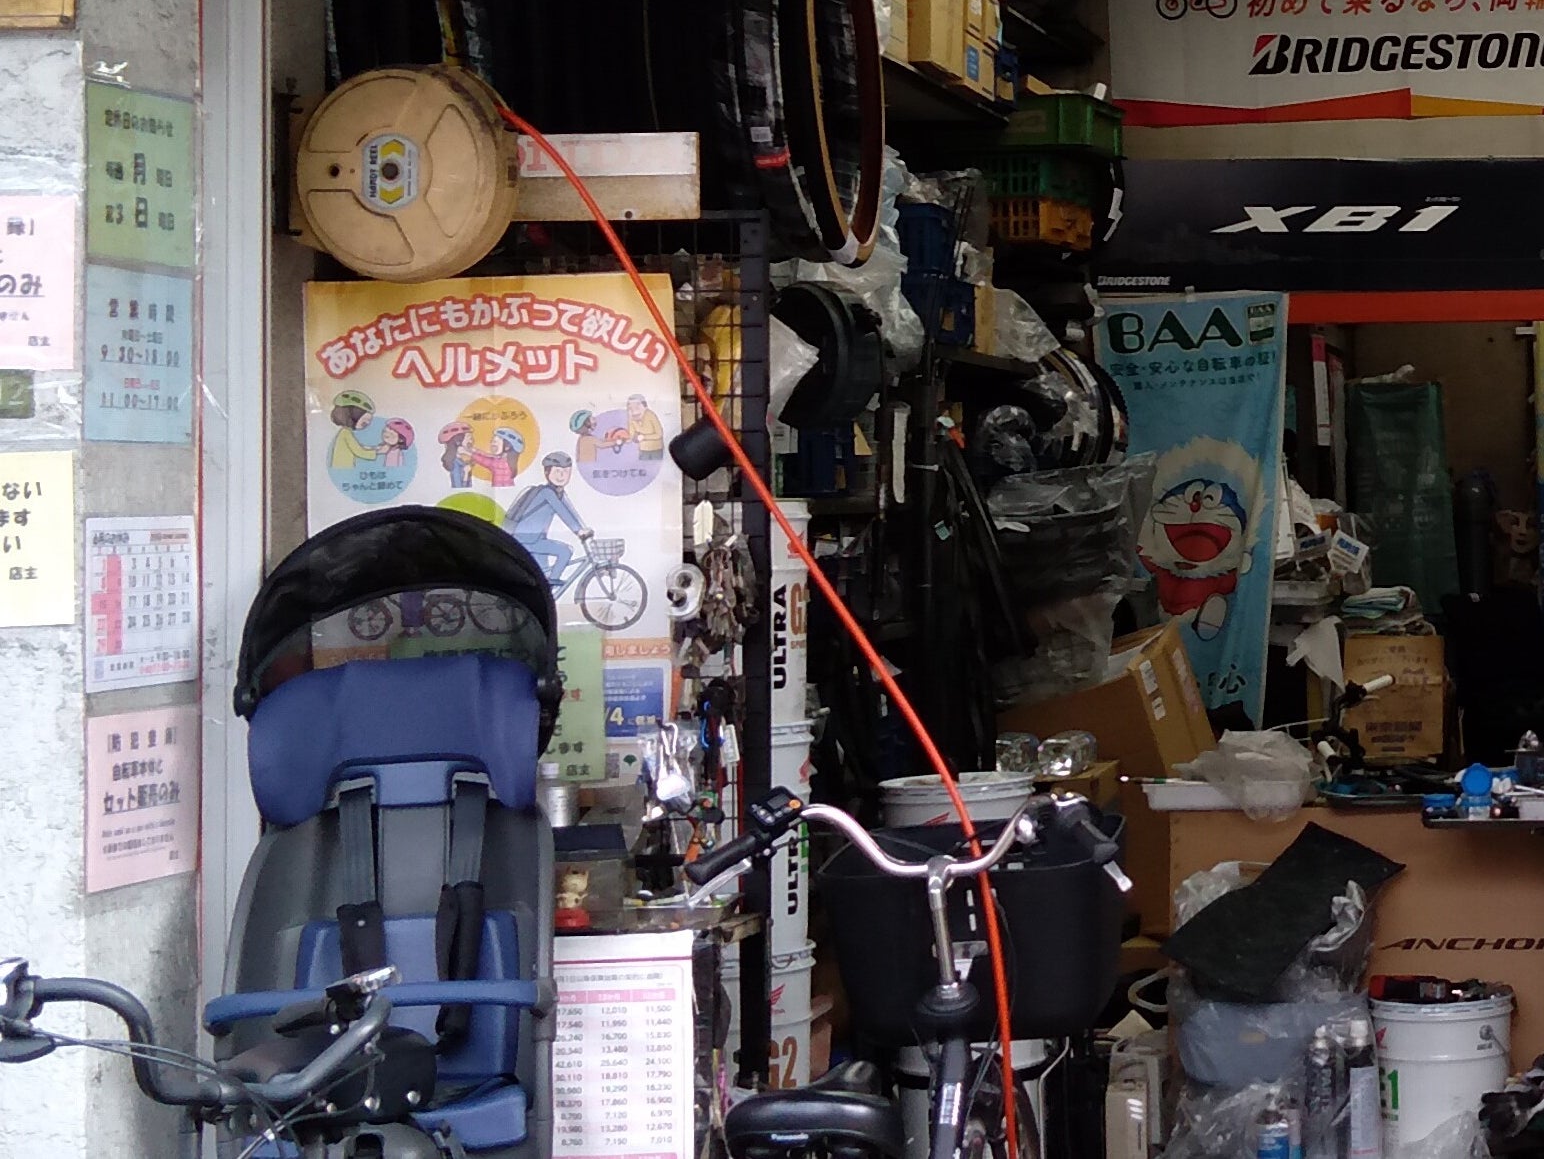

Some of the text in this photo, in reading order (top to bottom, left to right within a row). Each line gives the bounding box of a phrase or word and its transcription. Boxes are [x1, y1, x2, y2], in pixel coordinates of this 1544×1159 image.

[1210, 205, 1460, 235] XB1
[316, 291, 673, 377] あなたにもかぶって欲しい
[1106, 306, 1244, 354] BAA
[394, 340, 600, 389] ヘルメット
[2, 482, 42, 500] ない
[9, 566, 38, 580] 店主
[773, 584, 788, 689] ULTRA
